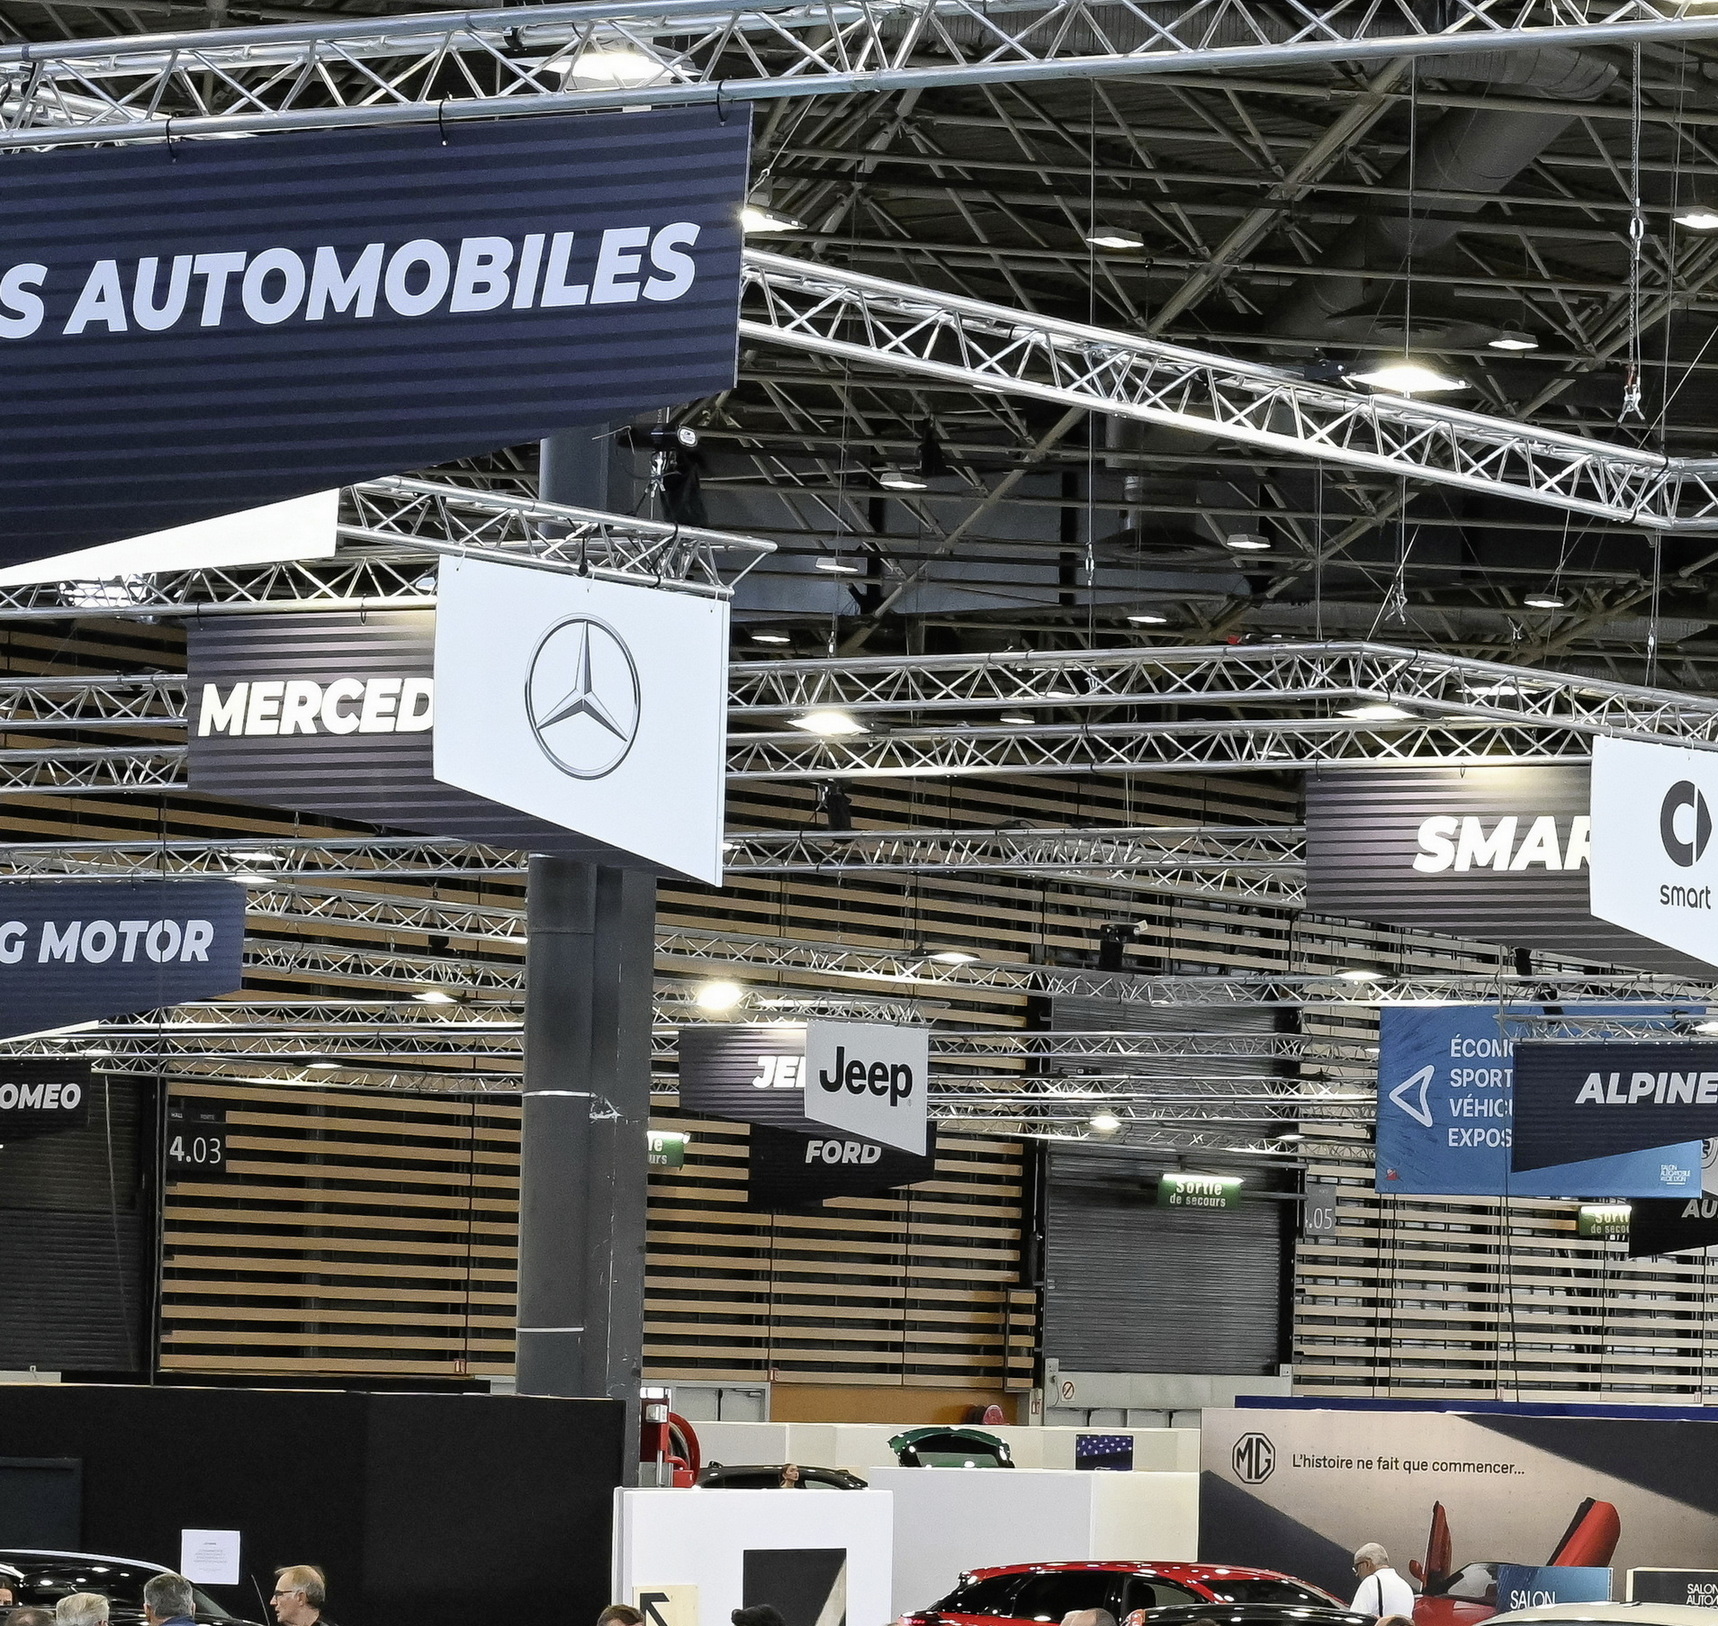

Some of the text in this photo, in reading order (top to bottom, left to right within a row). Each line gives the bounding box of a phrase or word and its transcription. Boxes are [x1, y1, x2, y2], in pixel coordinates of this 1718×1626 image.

[63, 222, 701, 336] AUTOMOBILES
[198, 677, 434, 737] MERCED
[1660, 884, 1712, 910] smart
[38, 919, 214, 963] MOTOR
[819, 1046, 913, 1107] Jeep
[169, 1135, 222, 1164] 4.03
[805, 1140, 881, 1164] FORD
[1169, 1193, 1226, 1208] de secours
[1176, 1180, 1223, 1196] Sortie
[1236, 1437, 1273, 1480] MG
[1356, 1458, 1373, 1470] ne
[1377, 1456, 1400, 1471] fait
[1403, 1459, 1429, 1474] que
